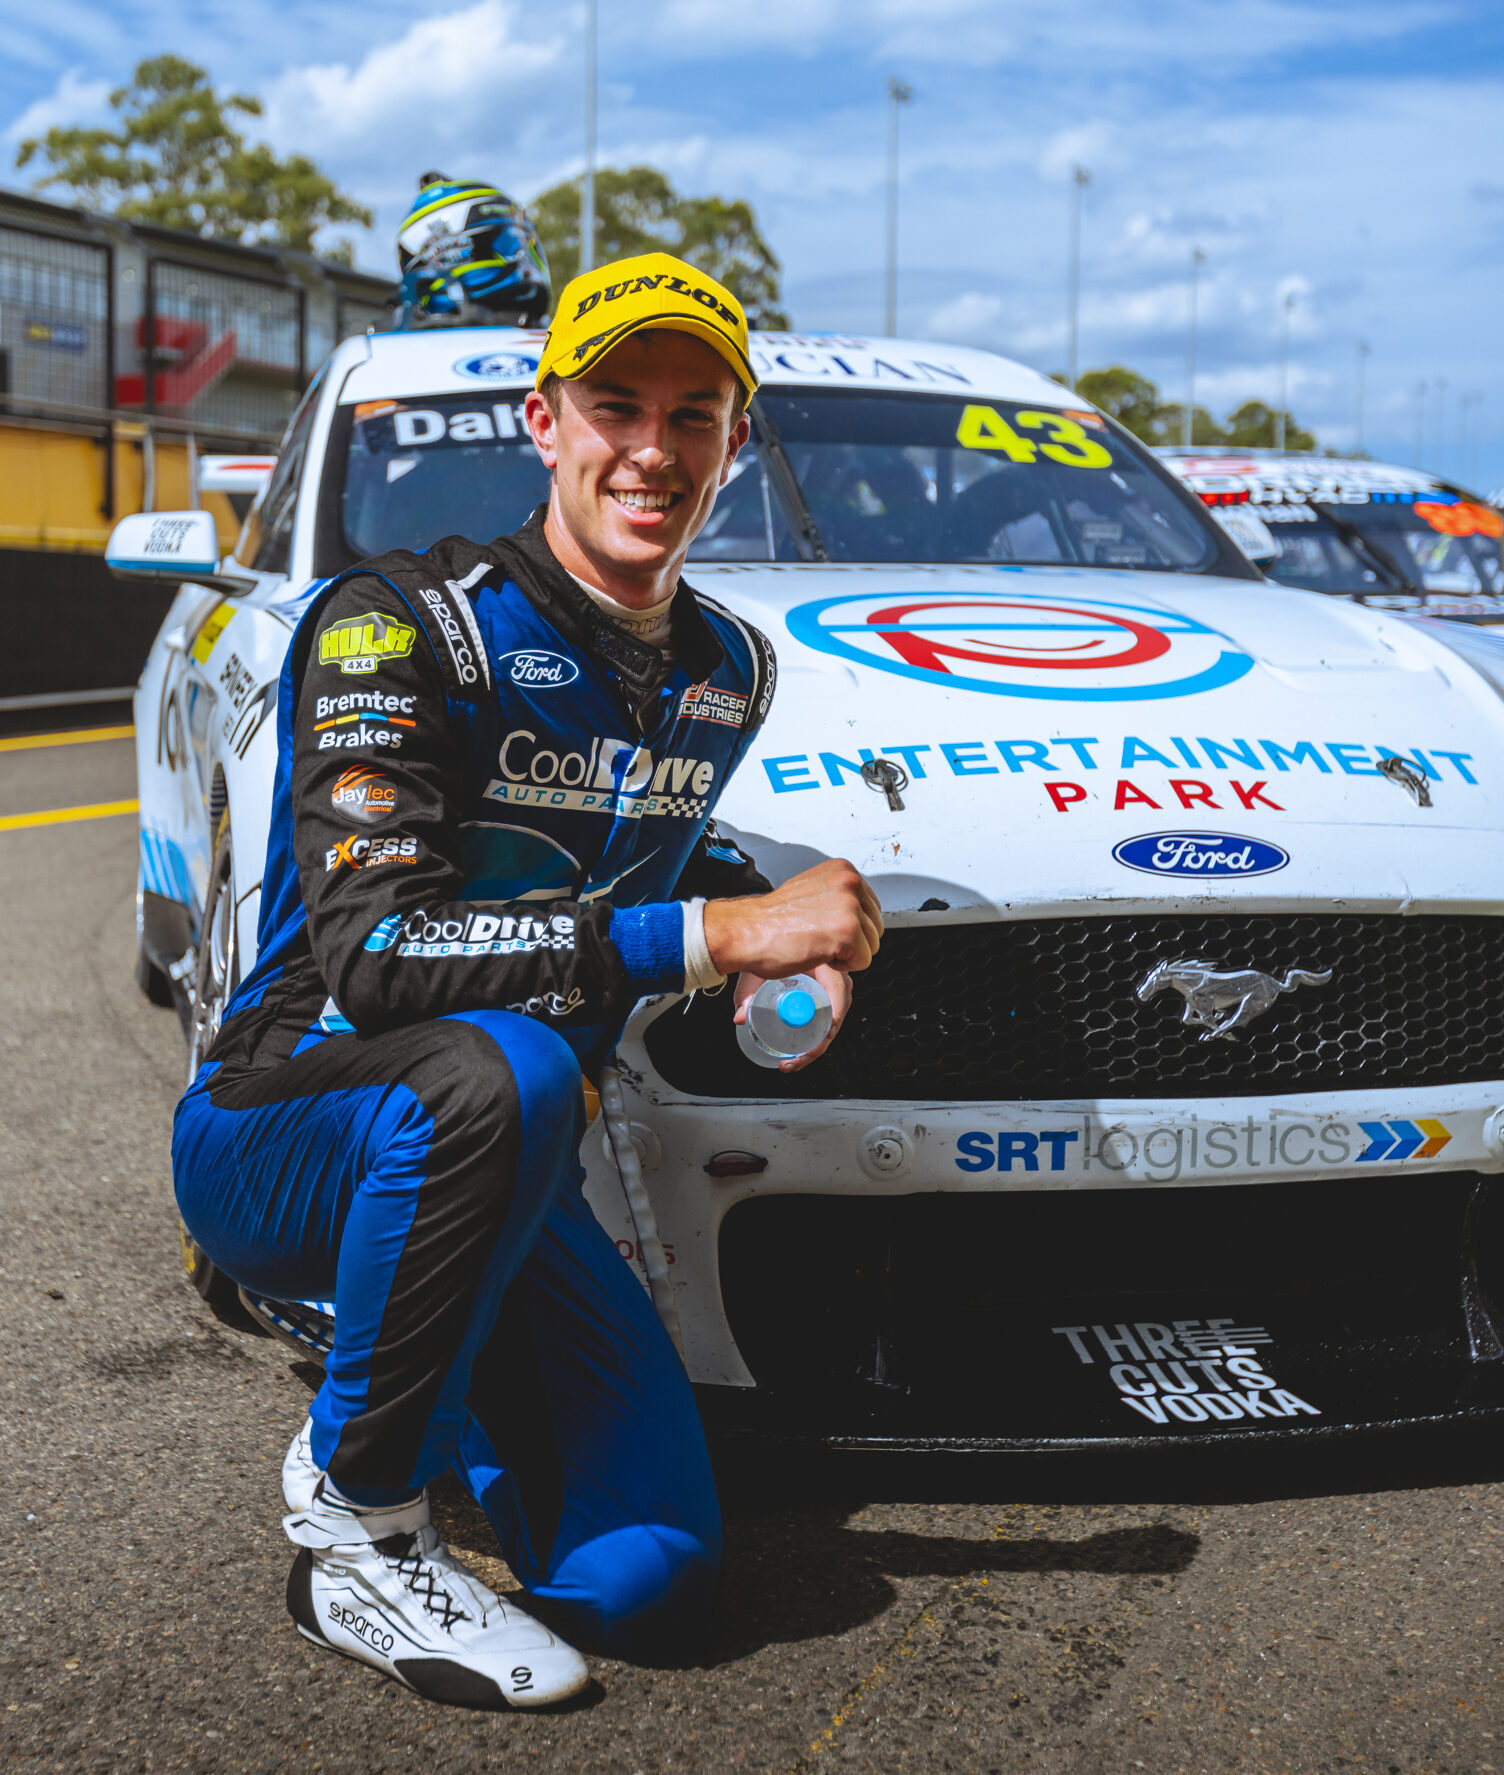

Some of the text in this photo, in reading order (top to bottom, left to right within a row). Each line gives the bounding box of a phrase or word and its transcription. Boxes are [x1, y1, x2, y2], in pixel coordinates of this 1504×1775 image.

[573, 274, 740, 326] DUNLOP
[956, 404, 1113, 468] 43
[321, 624, 412, 660] HULK
[419, 588, 477, 685] sparco
[511, 654, 563, 682] Ford
[316, 690, 415, 719] Bremtec
[679, 702, 744, 724] DUSTRIES
[703, 690, 747, 712] RACER
[318, 724, 403, 750] Brakes
[499, 730, 714, 796] CoolDive
[761, 736, 1480, 794] ENTERTAINMENT
[333, 784, 396, 805] Jaylec
[364, 799, 395, 807] Automotive
[491, 785, 659, 816] AUTO PARS
[1043, 779, 1288, 812] PARK
[325, 834, 418, 872] EXCESS
[365, 855, 417, 868] INJECTORS
[1151, 836, 1256, 870] Ford
[403, 910, 575, 943] CoolDrive
[402, 939, 527, 955] AUTO PARTS
[954, 1113, 1350, 1182] SRT logistics
[1051, 1318, 1274, 1364] THREE
[1109, 1356, 1278, 1397] CUTS
[1120, 1388, 1323, 1424] VODKA
[329, 1601, 395, 1657] sparco
